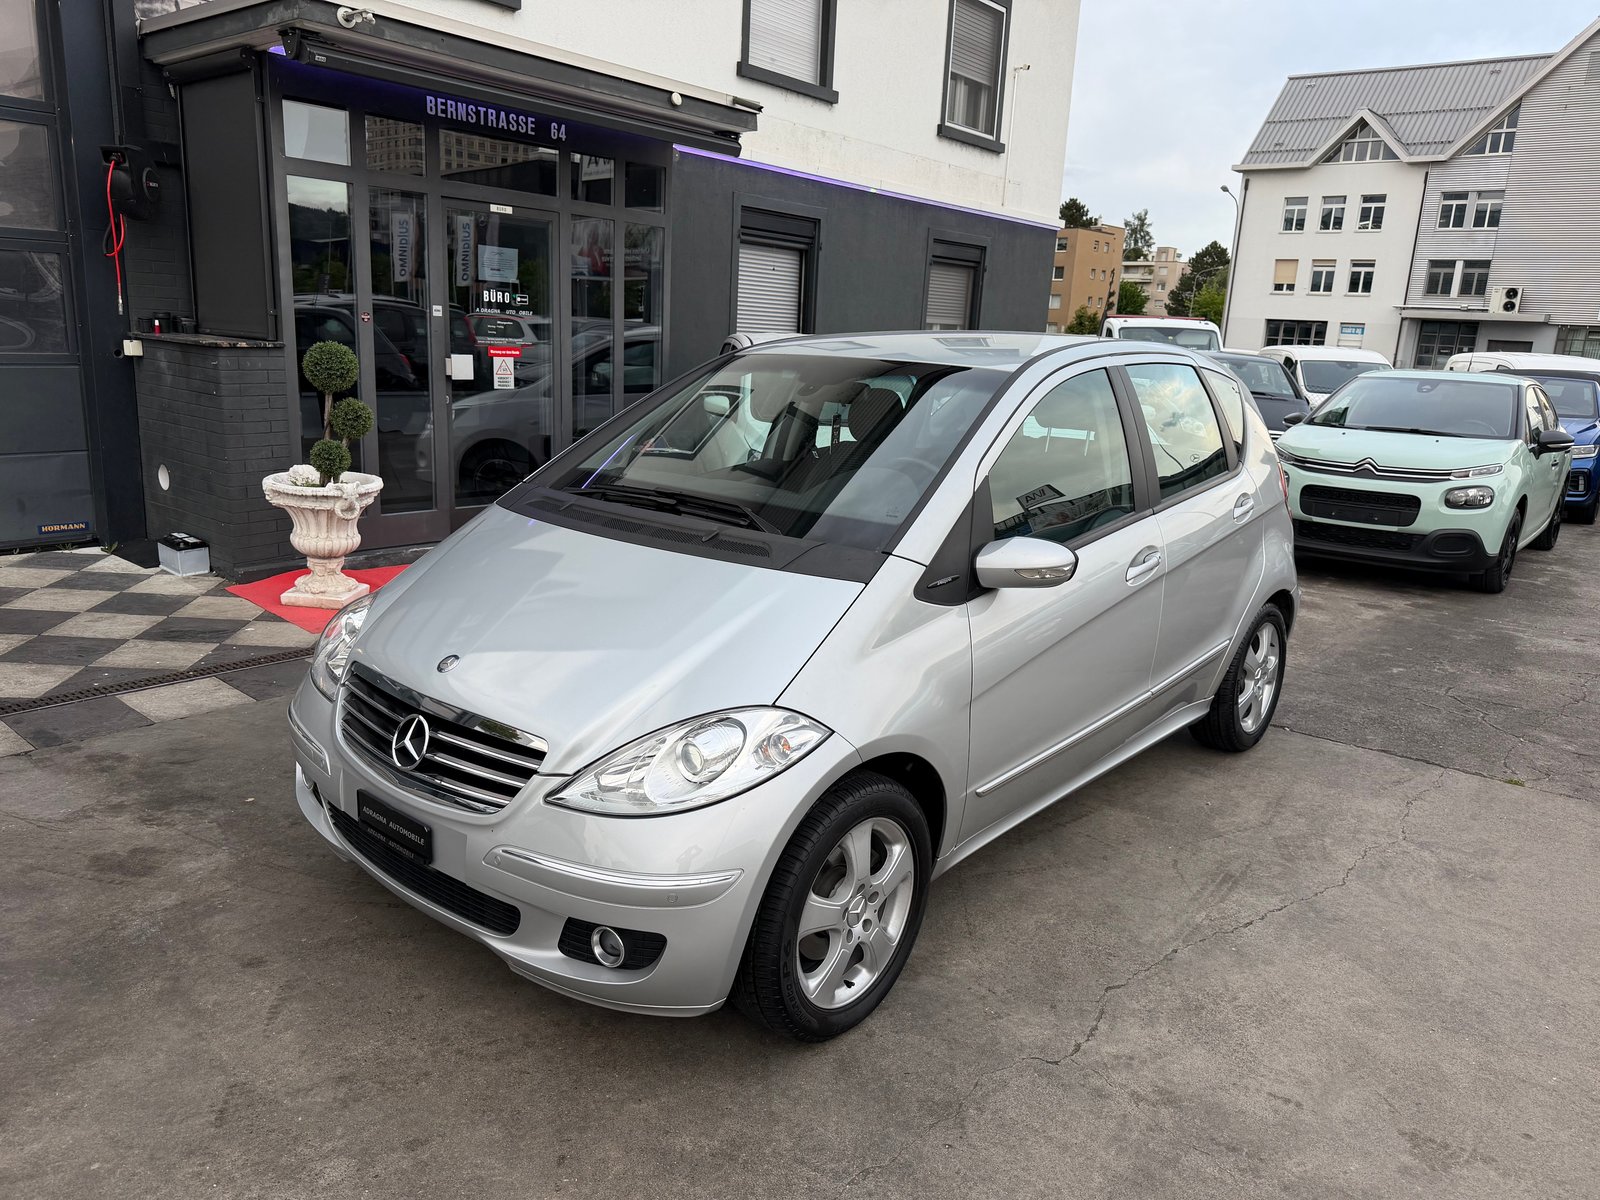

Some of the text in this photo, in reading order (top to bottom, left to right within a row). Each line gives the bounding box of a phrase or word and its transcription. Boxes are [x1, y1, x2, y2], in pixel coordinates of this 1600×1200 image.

[426, 95, 567, 142] BERNSTRASSE 64
[397, 219, 409, 277] OMNIDIUS
[461, 223, 471, 282] OMNIDIUS
[483, 288, 510, 304] BÜRO
[362, 805, 425, 846] ADRAGNA AUTOMOBILE
